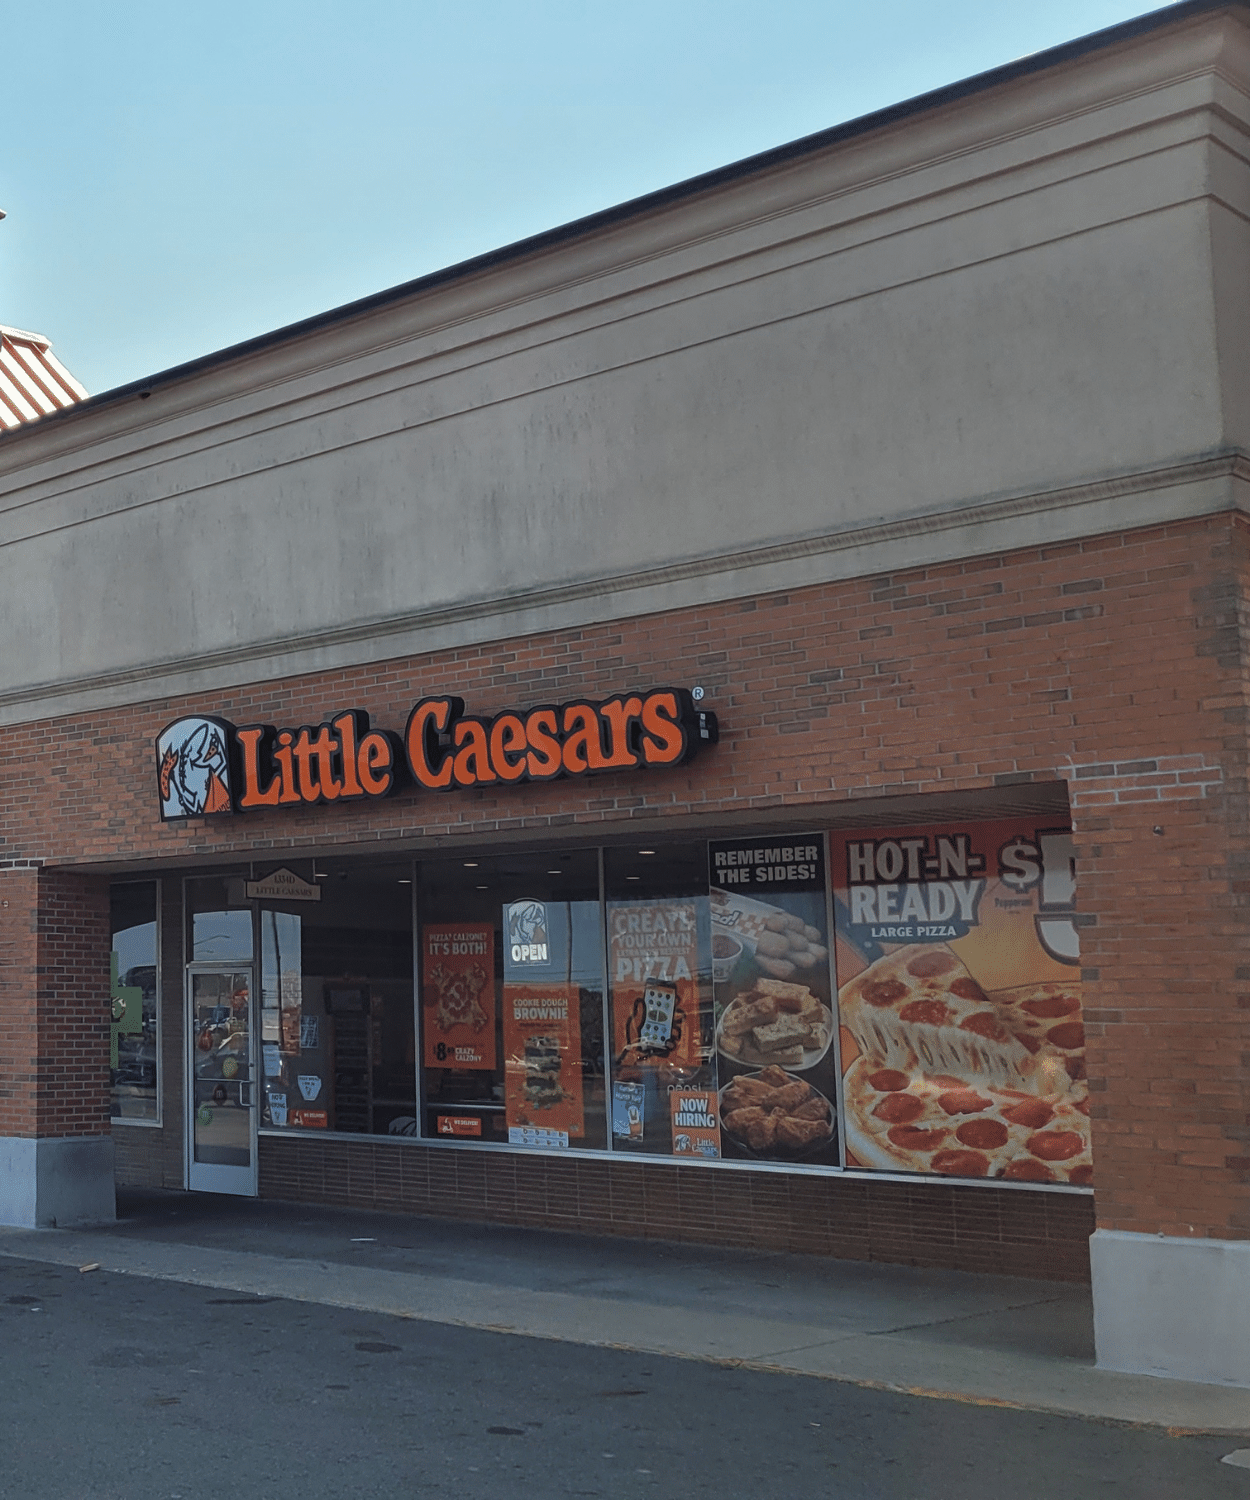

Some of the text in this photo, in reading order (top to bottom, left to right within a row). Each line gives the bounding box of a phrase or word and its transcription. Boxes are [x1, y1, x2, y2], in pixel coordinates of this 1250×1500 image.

[237, 693, 683, 807] Little Caesars
[715, 846, 818, 866] REMEMBER
[849, 837, 981, 882] HOT-N-
[717, 864, 816, 884] THE SIDES!
[851, 880, 982, 924] READY
[618, 932, 692, 948] YOUR OWN
[871, 925, 957, 938] LARGE PIZZA
[430, 942, 487, 955] IT'S BOTH!
[511, 943, 547, 961] OPEN
[616, 956, 692, 982] PIZZA
[513, 998, 568, 1007] COOKIE DOUGH
[513, 1007, 568, 1020] BROWNIE
[679, 1098, 708, 1112] NOW
[674, 1112, 715, 1128] HIRING
